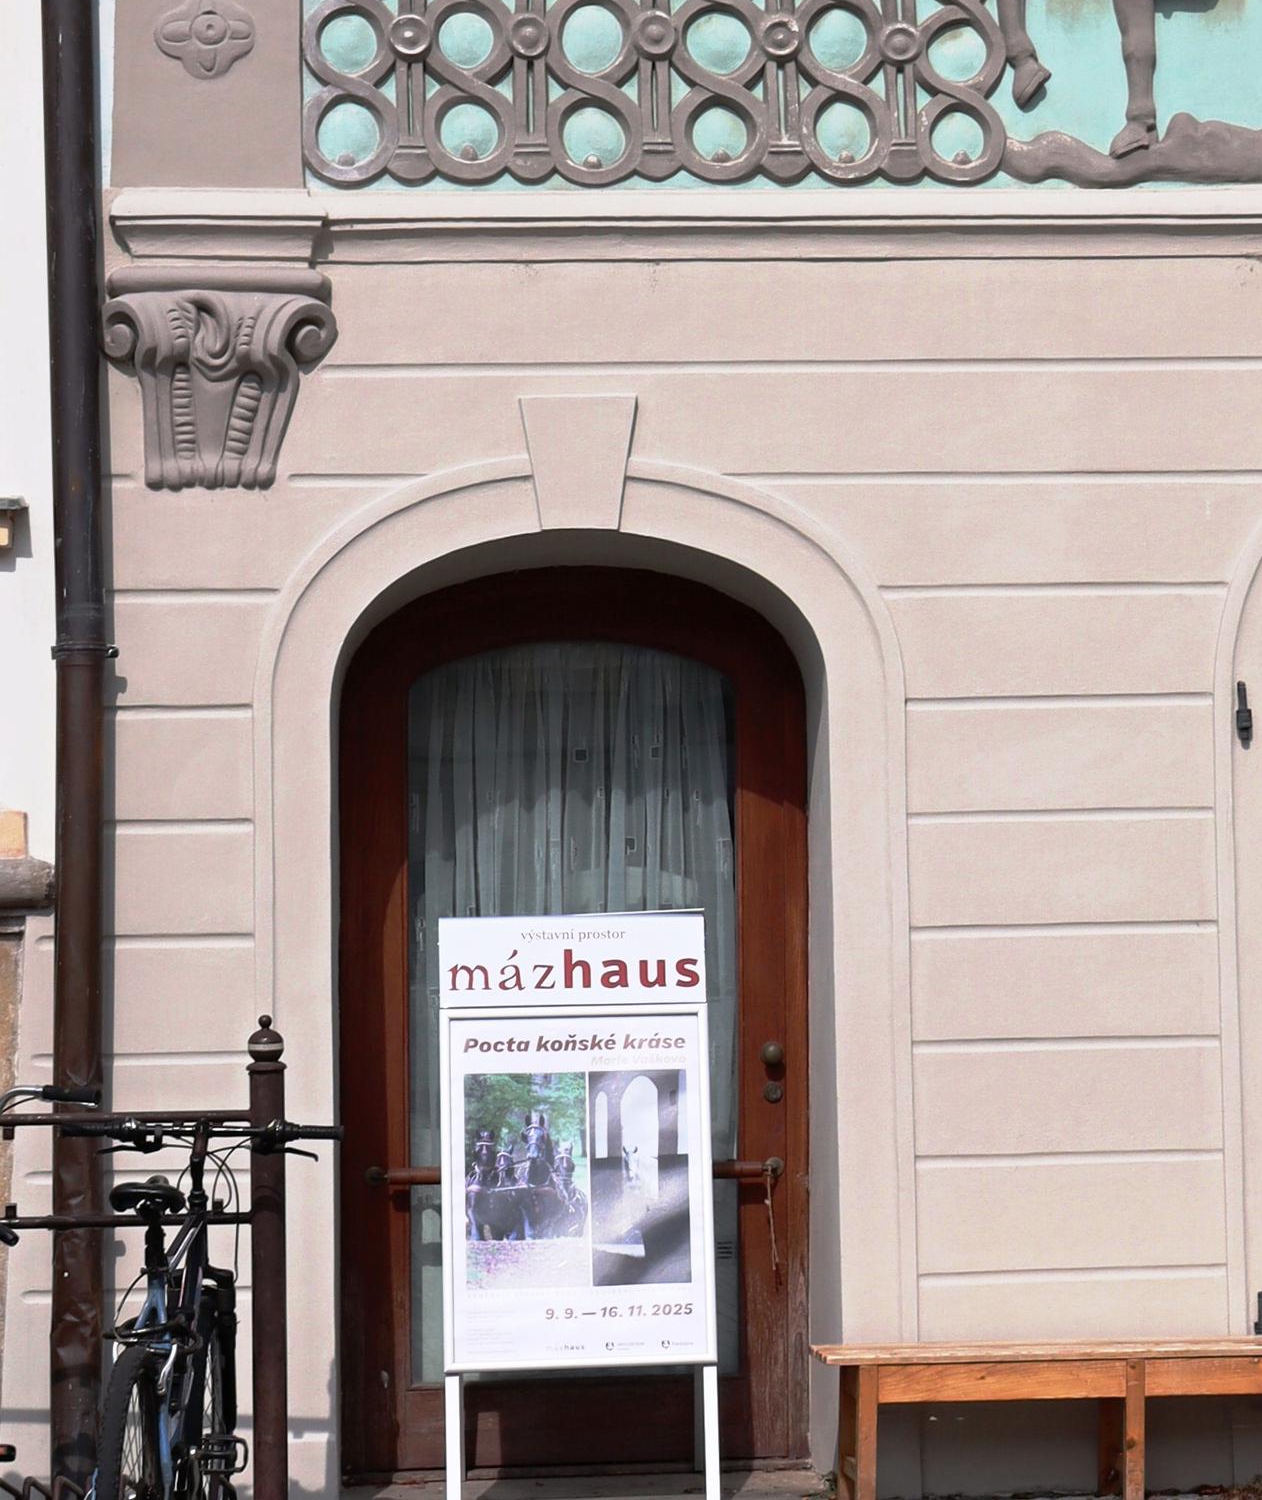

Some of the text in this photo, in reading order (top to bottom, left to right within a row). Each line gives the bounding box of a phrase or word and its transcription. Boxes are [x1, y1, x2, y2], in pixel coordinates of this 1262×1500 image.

[521, 929, 626, 943] výstavní prostor
[448, 949, 700, 991] mázhaus
[463, 1033, 687, 1054] Pocta koňské kráse
[545, 1308, 559, 1320] 9.
[564, 1307, 579, 1320] 9.
[601, 1306, 623, 1318] 16.
[627, 1304, 647, 1317] 11.
[651, 1302, 694, 1316] 2025
